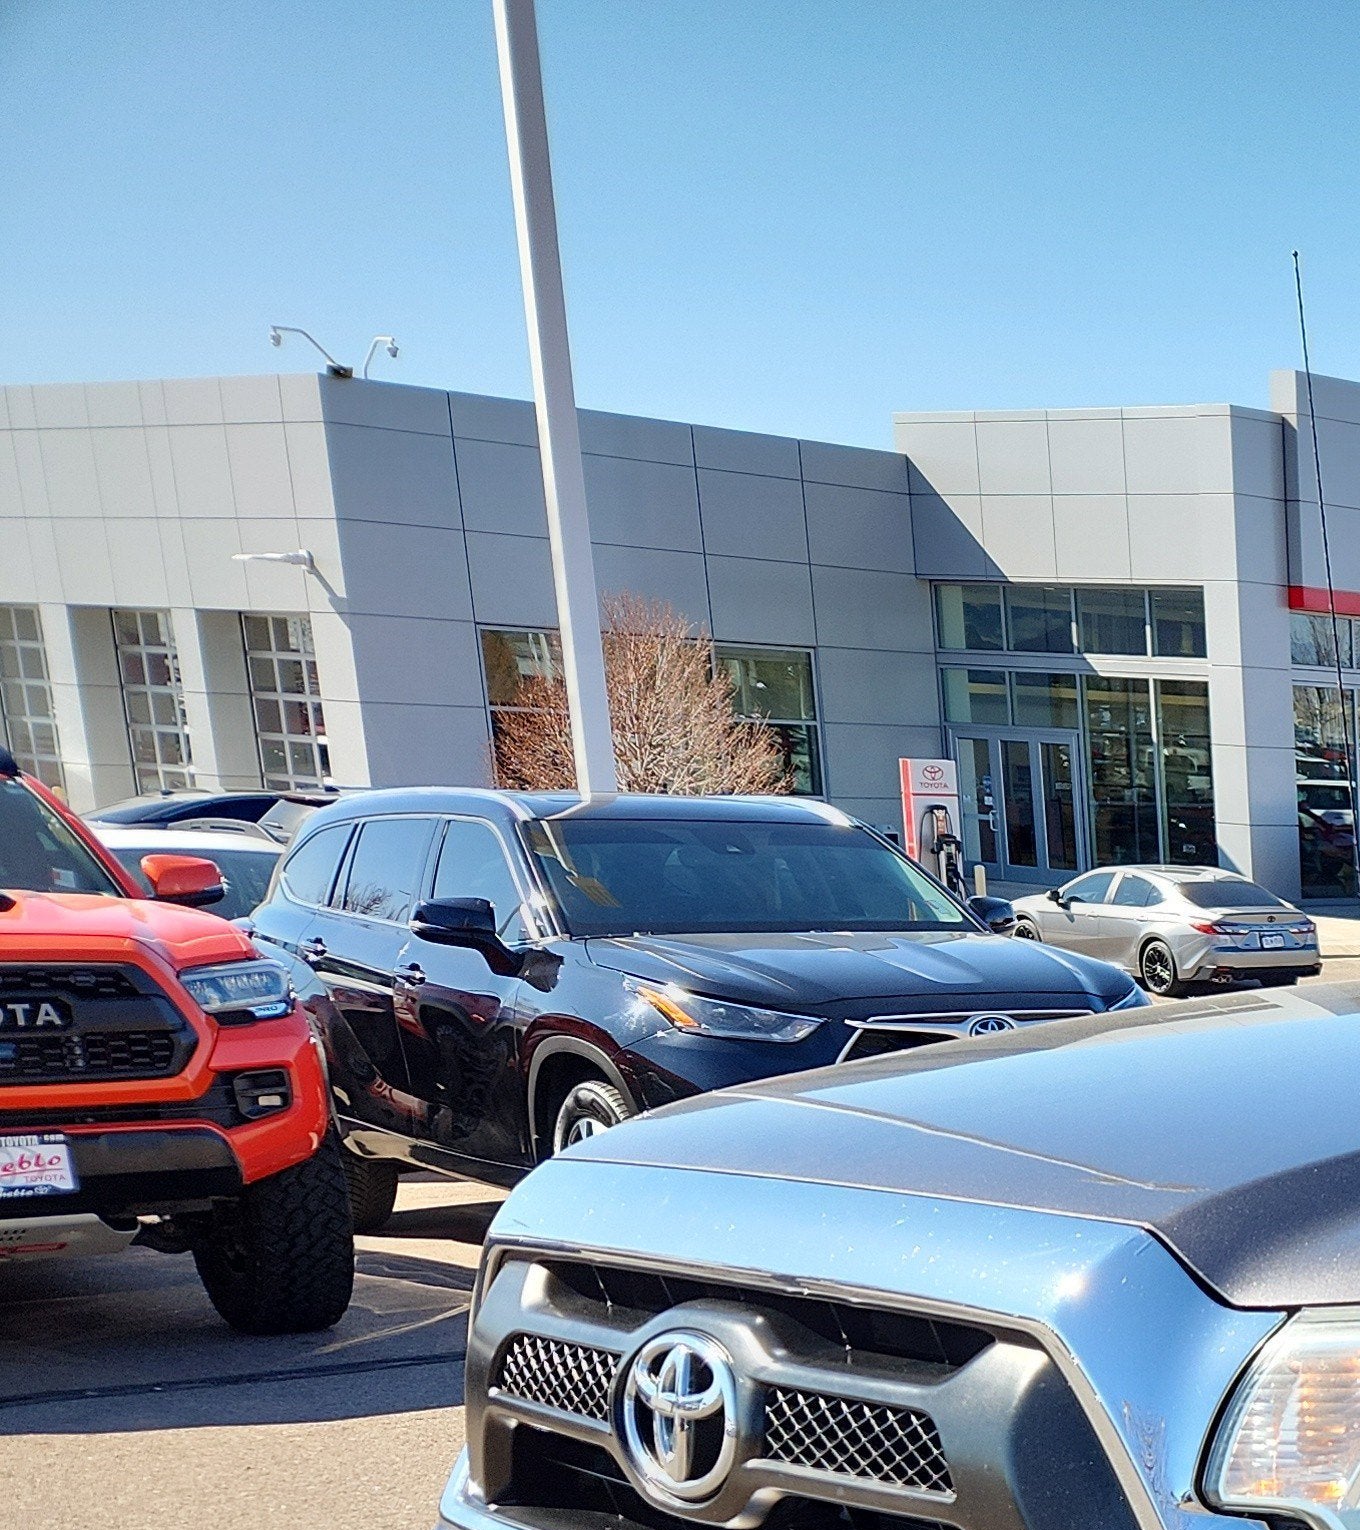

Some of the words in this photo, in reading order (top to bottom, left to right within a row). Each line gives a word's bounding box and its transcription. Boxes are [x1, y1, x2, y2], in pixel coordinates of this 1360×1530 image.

[919, 781, 949, 790] TOYOTA
[0, 1152, 62, 1172] eblo
[24, 1173, 67, 1182] TOYOTA
